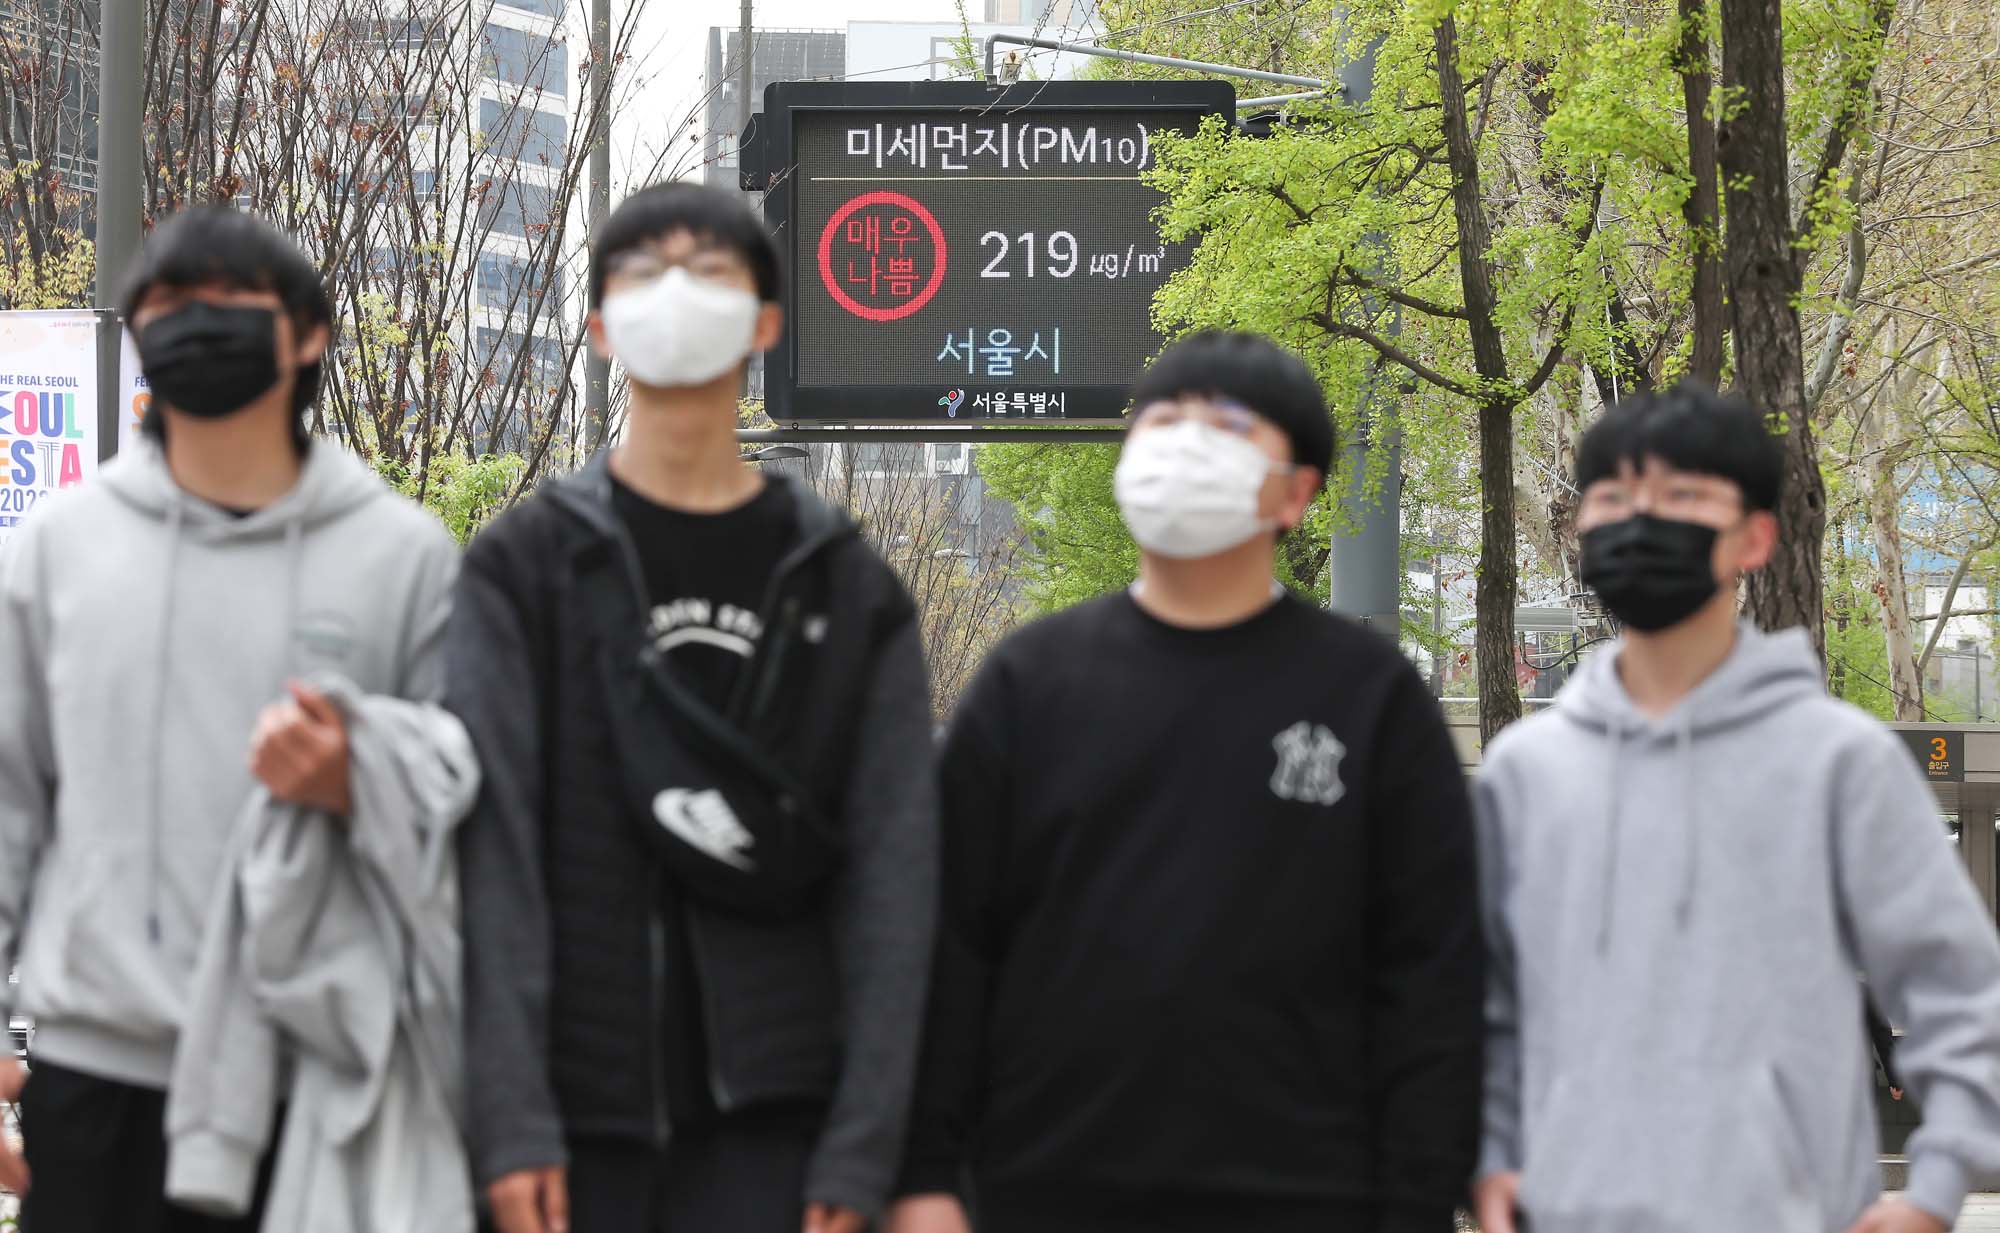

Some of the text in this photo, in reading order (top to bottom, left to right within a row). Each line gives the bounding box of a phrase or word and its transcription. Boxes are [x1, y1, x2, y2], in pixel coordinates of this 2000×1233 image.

[847, 123, 1149, 170] 미세먼지(PM10)
[848, 216, 919, 255] 매우
[980, 231, 1077, 278] 219
[849, 256, 919, 296] 나쁨
[937, 327, 1059, 376] 서울시
[0, 375, 79, 387] HE REAL SEOUL
[972, 392, 1065, 413] 서울특별시
[1930, 737, 1947, 760] 3
